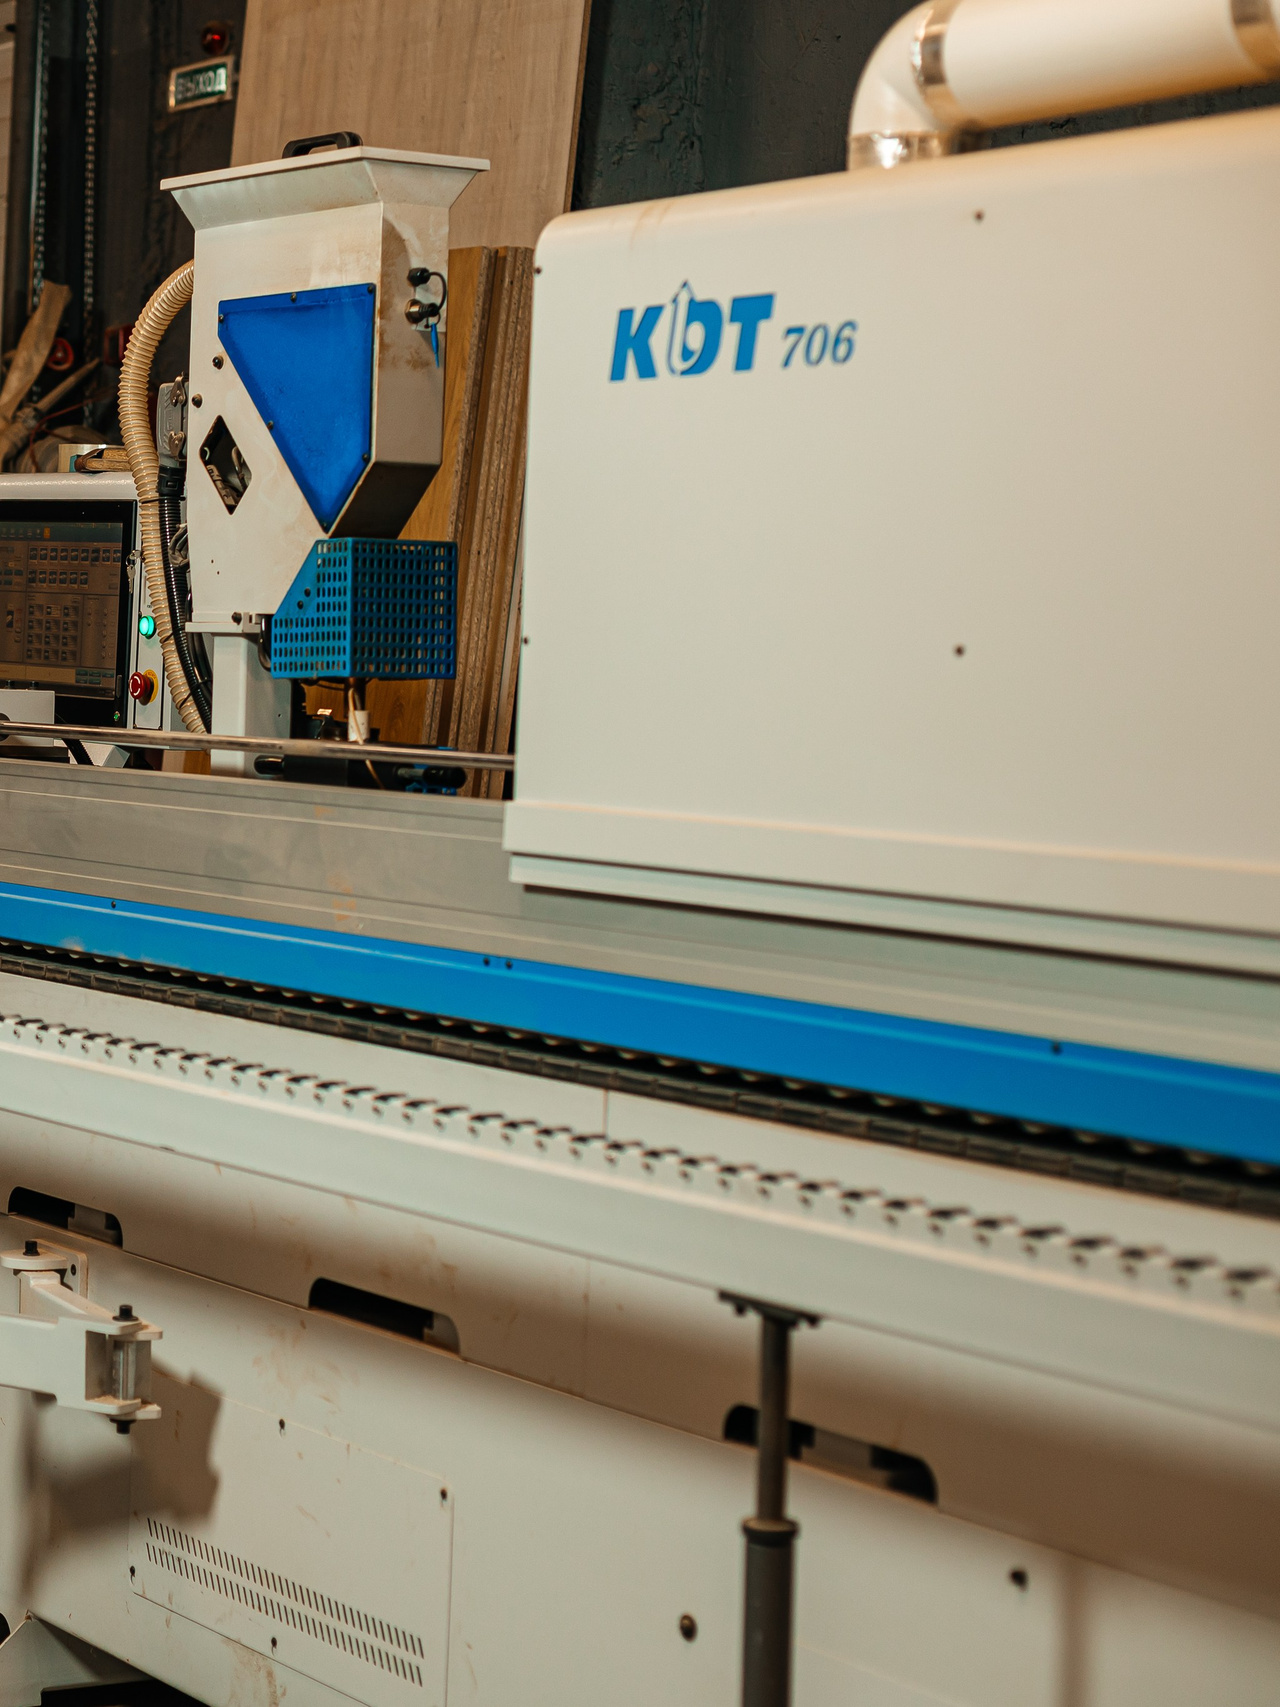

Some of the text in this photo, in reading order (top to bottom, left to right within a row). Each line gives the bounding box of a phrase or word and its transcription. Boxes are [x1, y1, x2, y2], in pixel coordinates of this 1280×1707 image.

[177, 67, 227, 99] ВЫХОД
[609, 280, 858, 382] KDT 706
